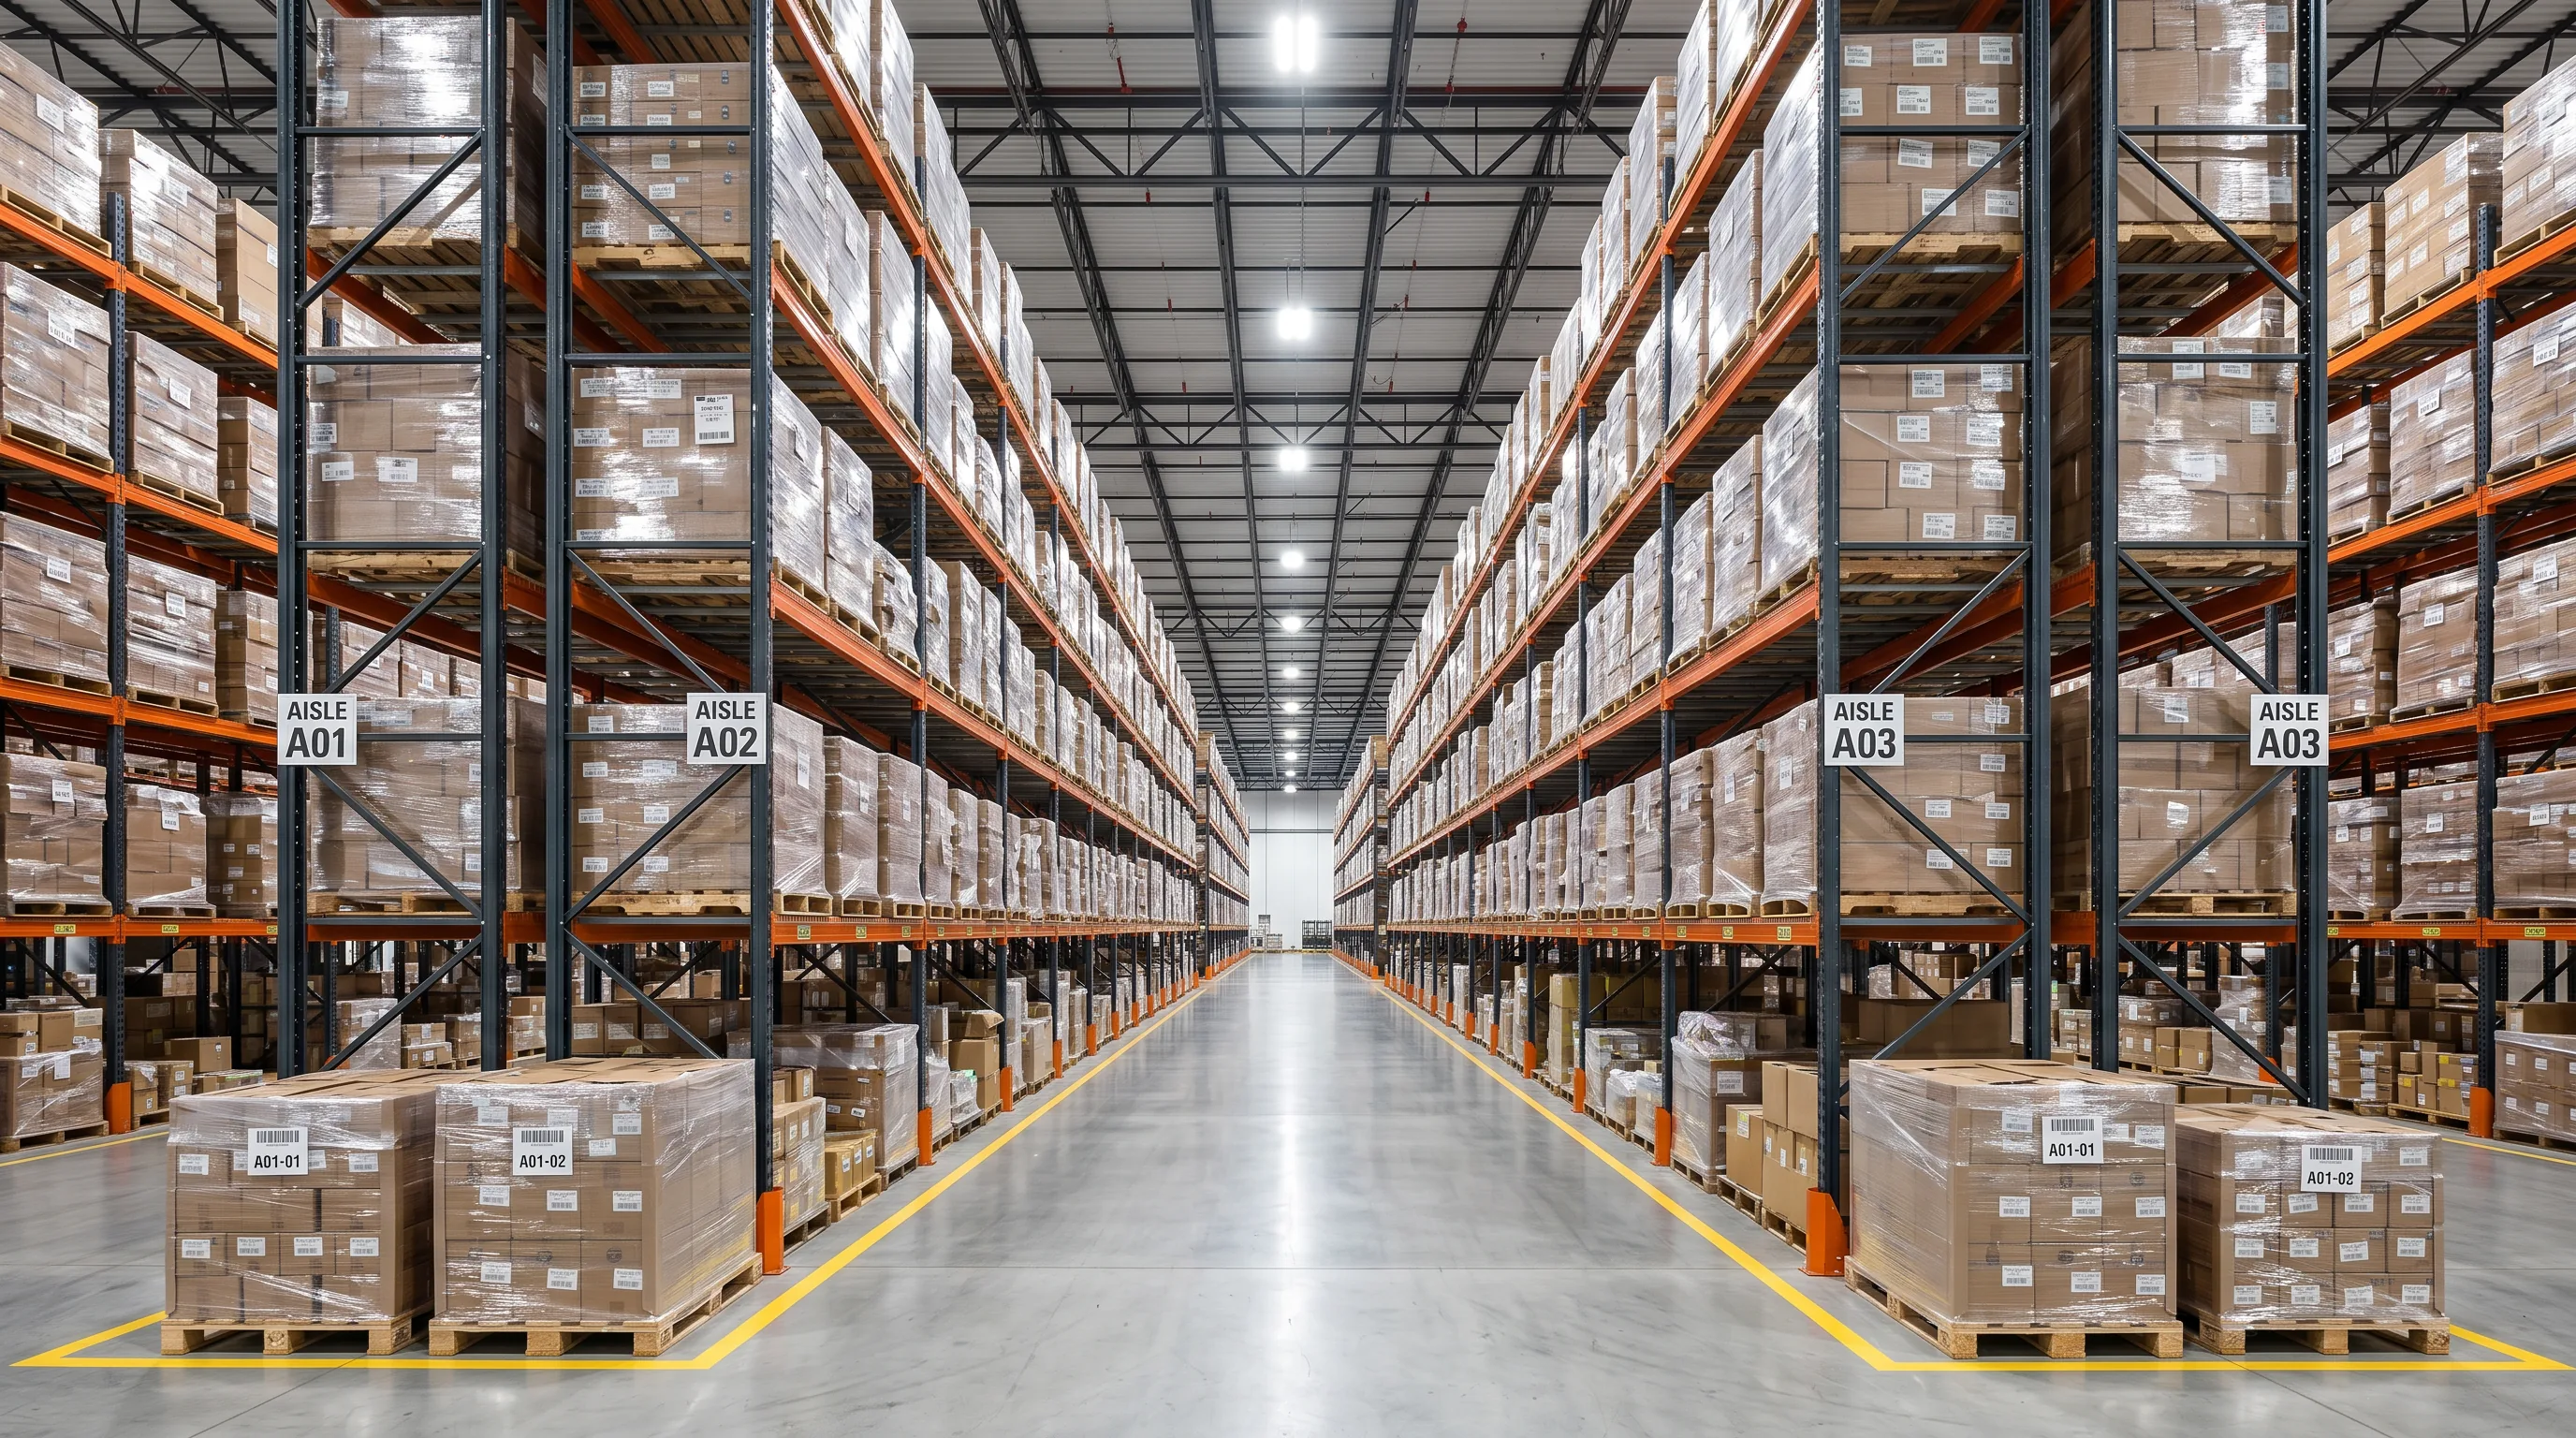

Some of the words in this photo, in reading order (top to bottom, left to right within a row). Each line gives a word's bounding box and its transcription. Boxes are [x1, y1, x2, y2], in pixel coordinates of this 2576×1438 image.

[286, 700, 347, 721] AISLE
[695, 699, 756, 720] AISLE
[1833, 701, 1894, 722] AISLE
[2259, 701, 2319, 722] AISLE
[285, 726, 345, 758] A01
[693, 726, 758, 758] A02
[1832, 727, 1896, 759] A03
[2257, 727, 2320, 759] A03
[2048, 1142, 2094, 1157] A01-01
[254, 1154, 300, 1168] A01-01
[519, 1154, 566, 1168] A01-02
